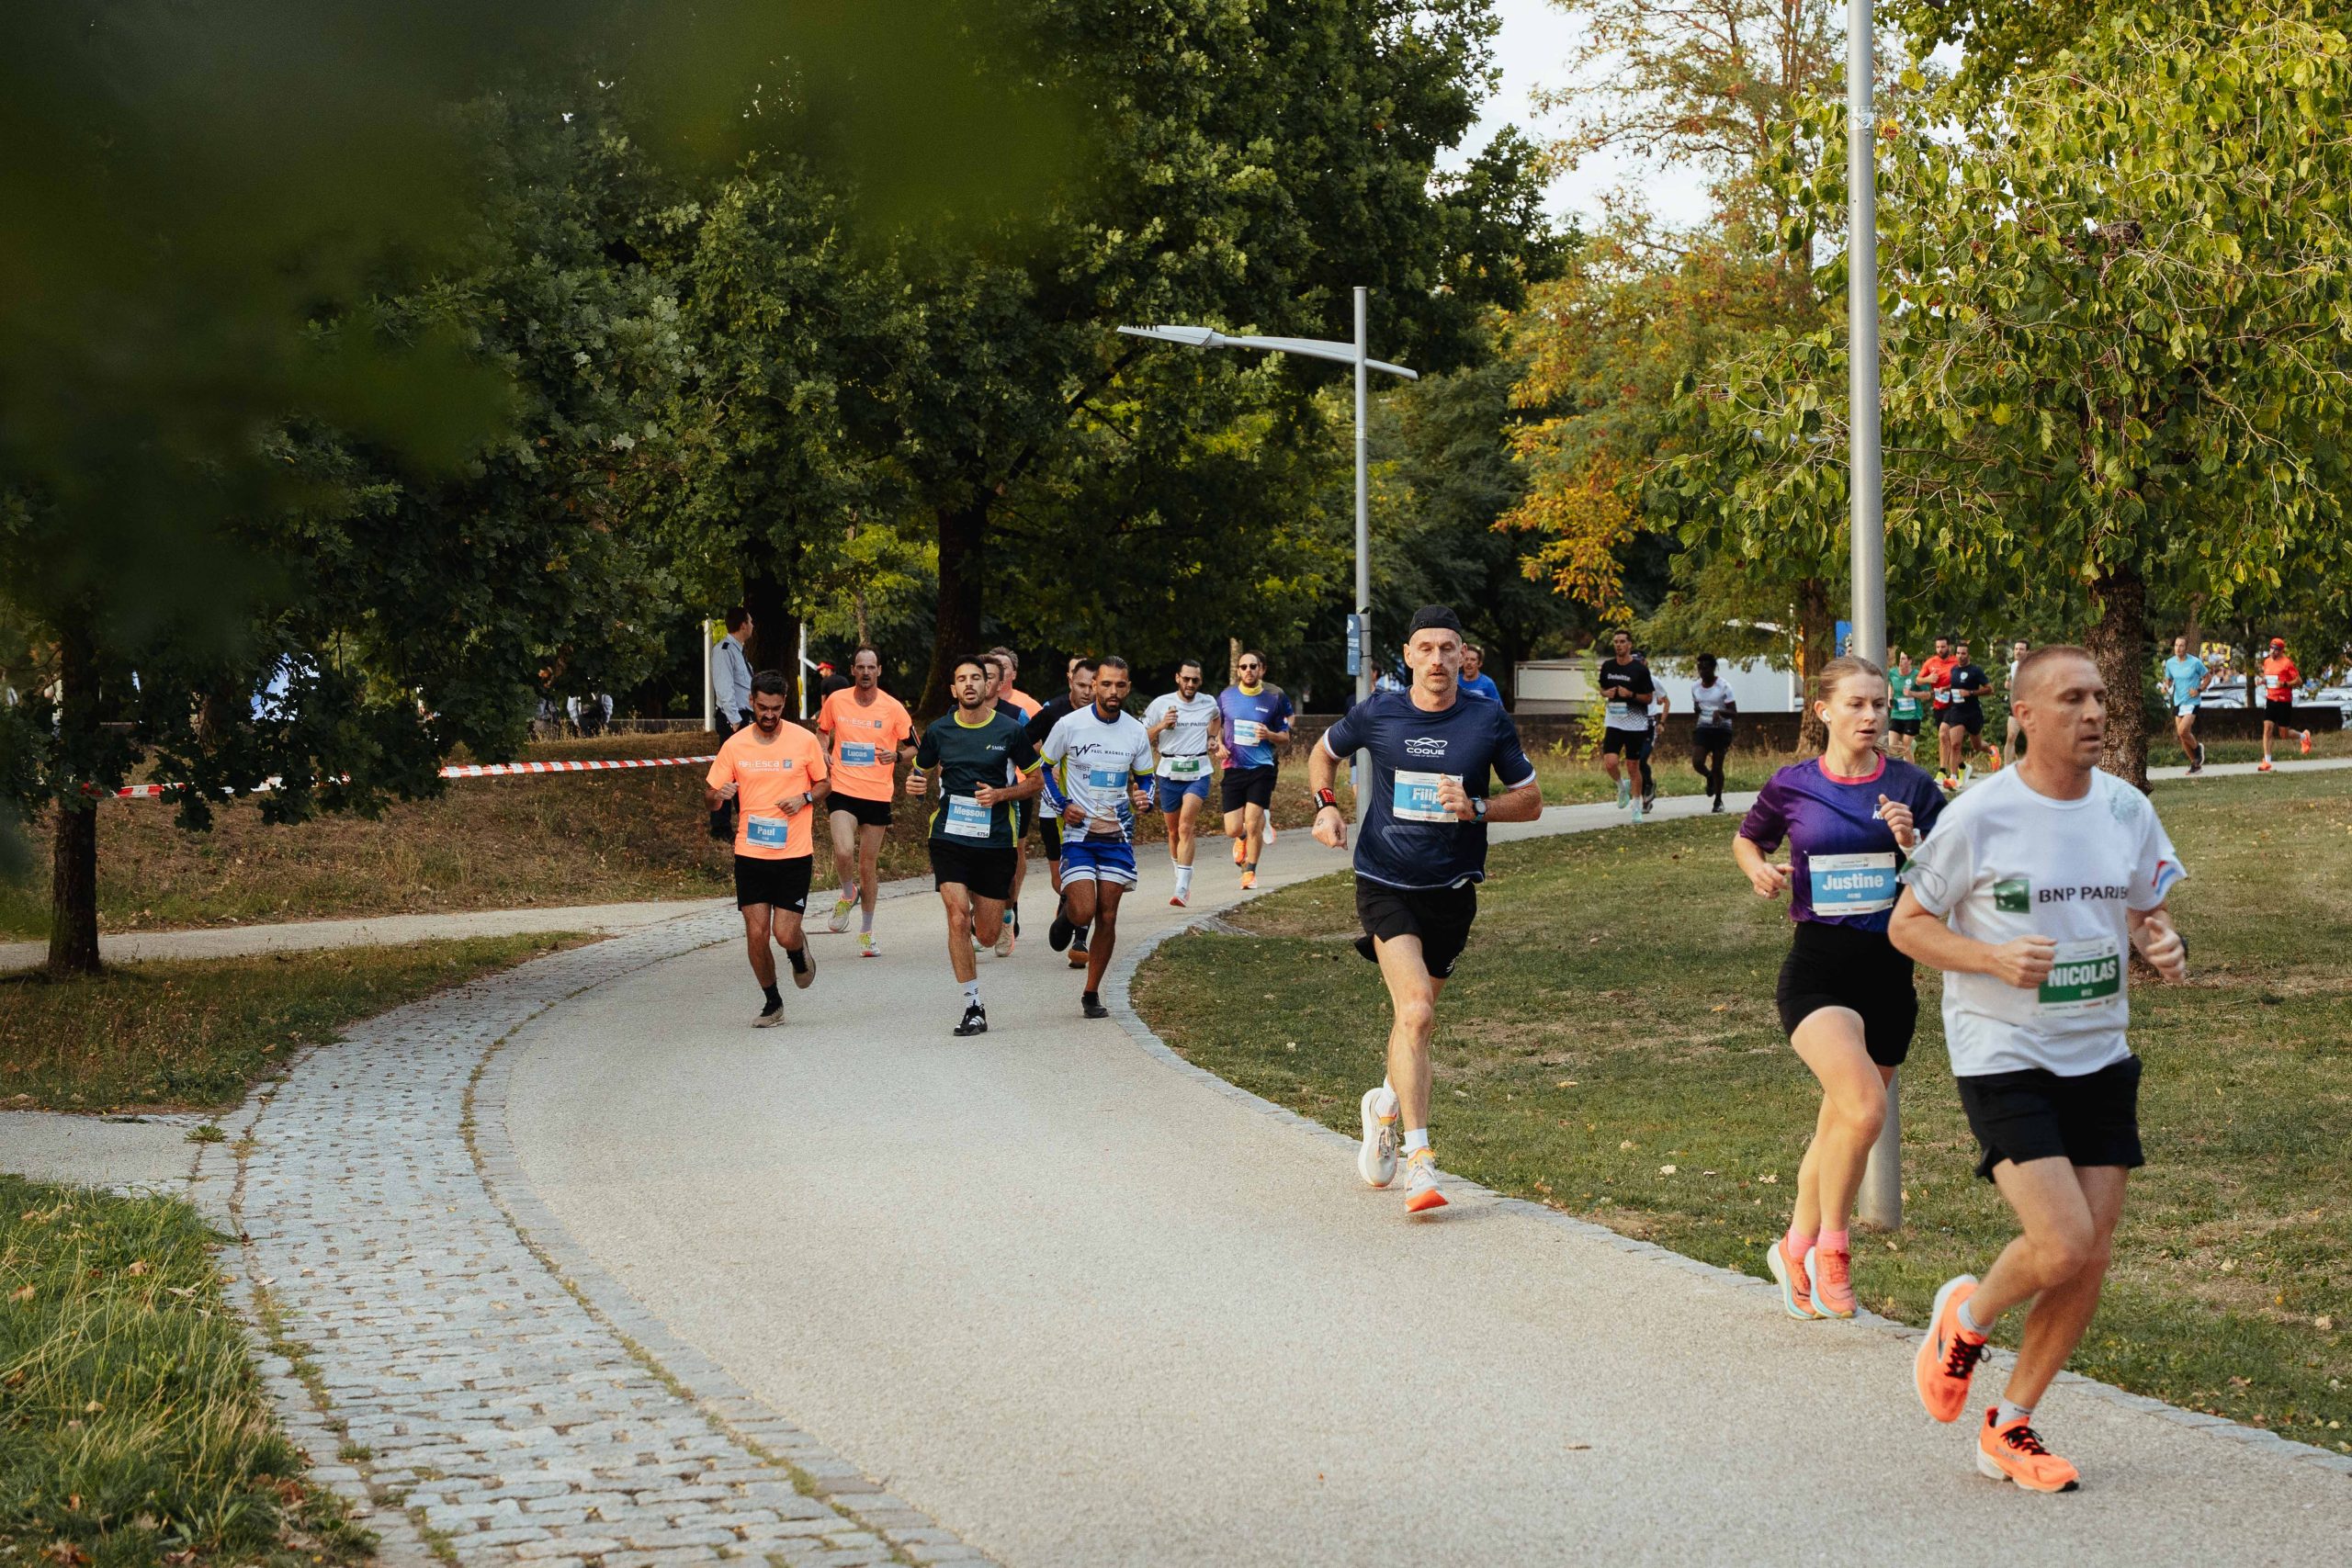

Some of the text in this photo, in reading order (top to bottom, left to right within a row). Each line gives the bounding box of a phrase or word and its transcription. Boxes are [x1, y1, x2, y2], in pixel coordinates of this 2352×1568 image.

[1607, 672, 1631, 682] Deloitte
[847, 749, 868, 758] Lucas
[1406, 747, 1445, 756] COQUE
[954, 805, 986, 818] Messon
[757, 826, 775, 836] Paul
[1822, 874, 1884, 891] Justine
[2039, 887, 2076, 903] BNP
[2048, 960, 2117, 987] NICOLAS
